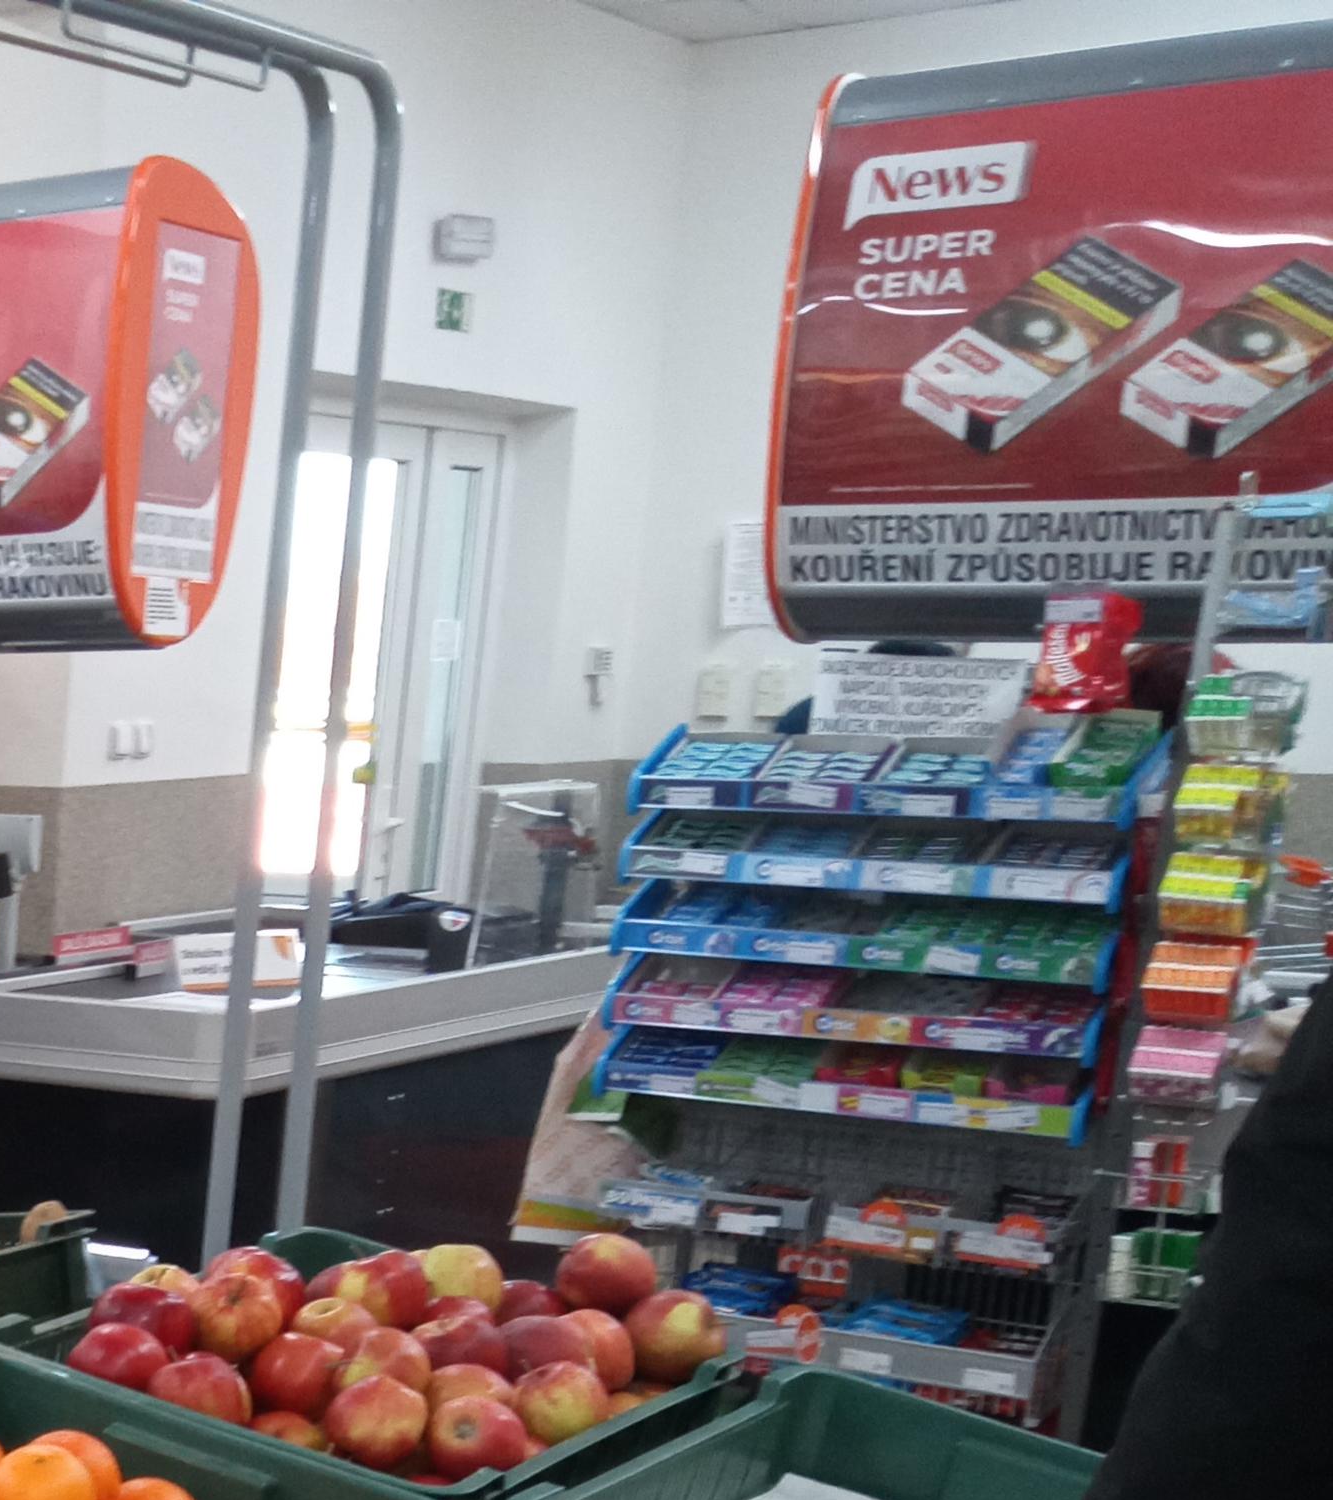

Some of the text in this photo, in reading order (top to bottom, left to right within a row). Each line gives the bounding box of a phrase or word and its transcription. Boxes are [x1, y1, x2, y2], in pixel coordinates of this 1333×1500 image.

[867, 160, 1007, 204] News
[858, 229, 997, 266] SUPER
[853, 267, 968, 302] CENA
[788, 513, 990, 546] MINISTERSTVO
[997, 508, 1229, 544] ZDRAVOTNICTV
[789, 547, 936, 583] KOUŘENÍ
[946, 546, 1155, 582] ZPŮSOBUJE
